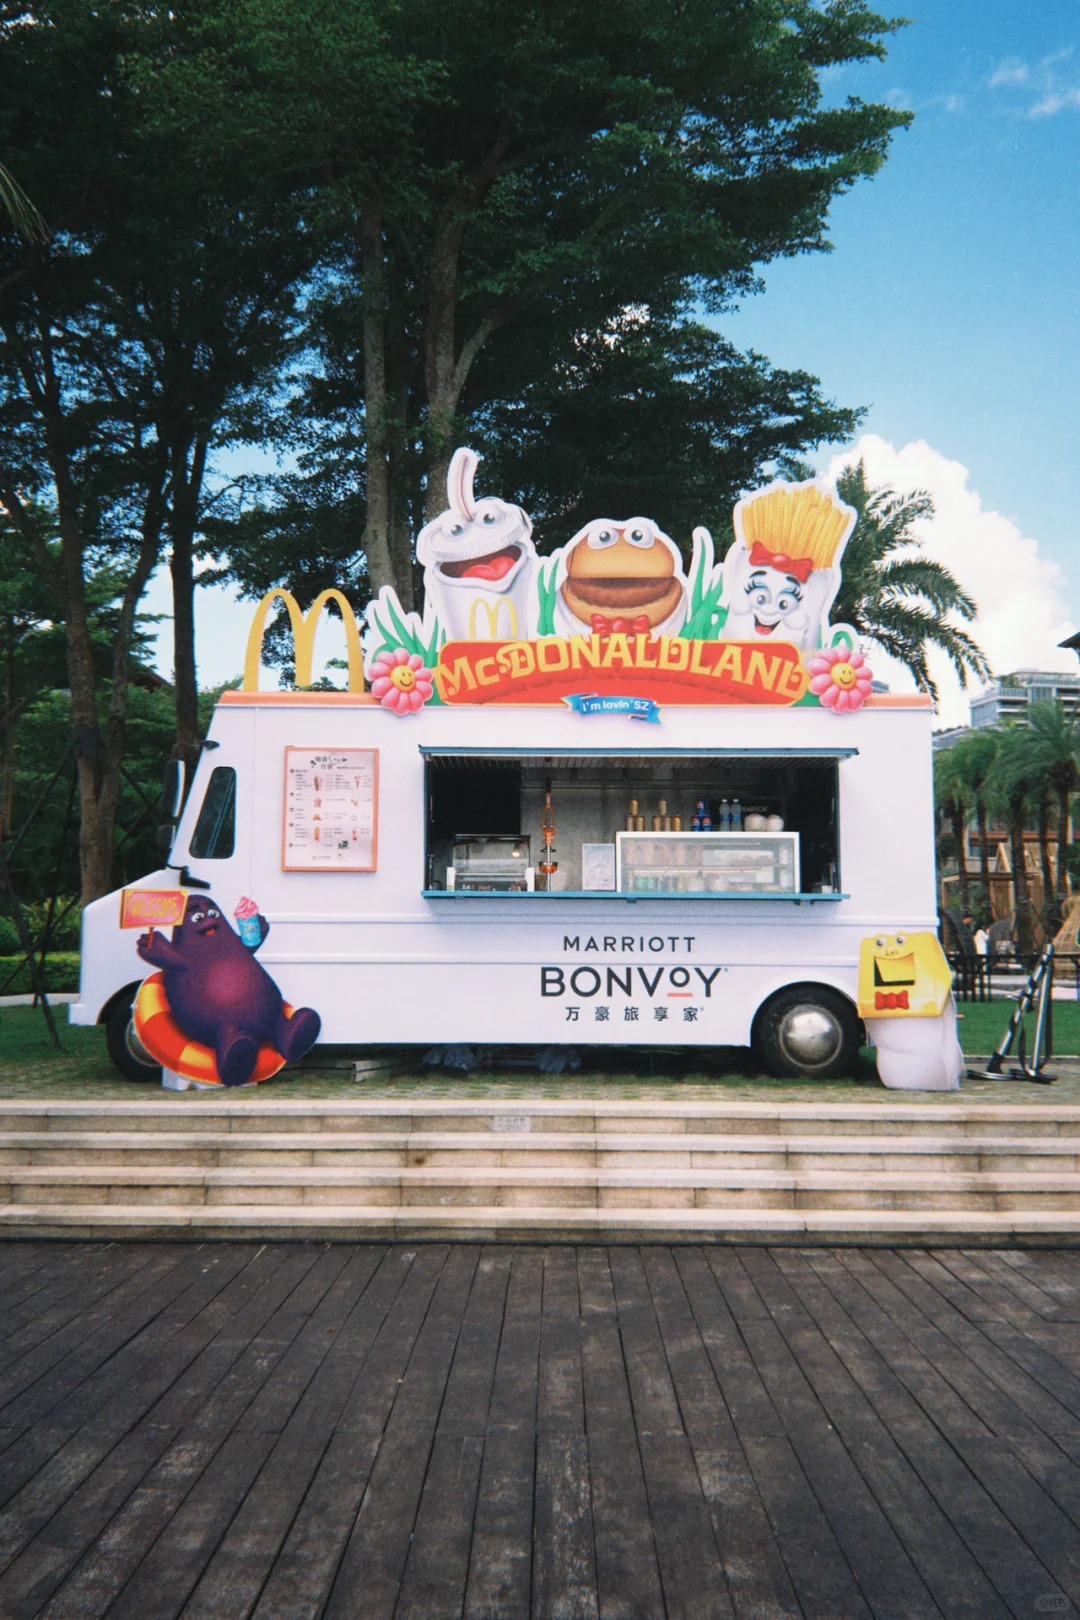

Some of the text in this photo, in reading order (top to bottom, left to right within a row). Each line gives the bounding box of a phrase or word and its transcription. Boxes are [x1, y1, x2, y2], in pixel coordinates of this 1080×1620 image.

[563, 936, 696, 952] MARRIOTT
[541, 966, 722, 997] BONVOY
[565, 1006, 699, 1021] 万豪旅享家
